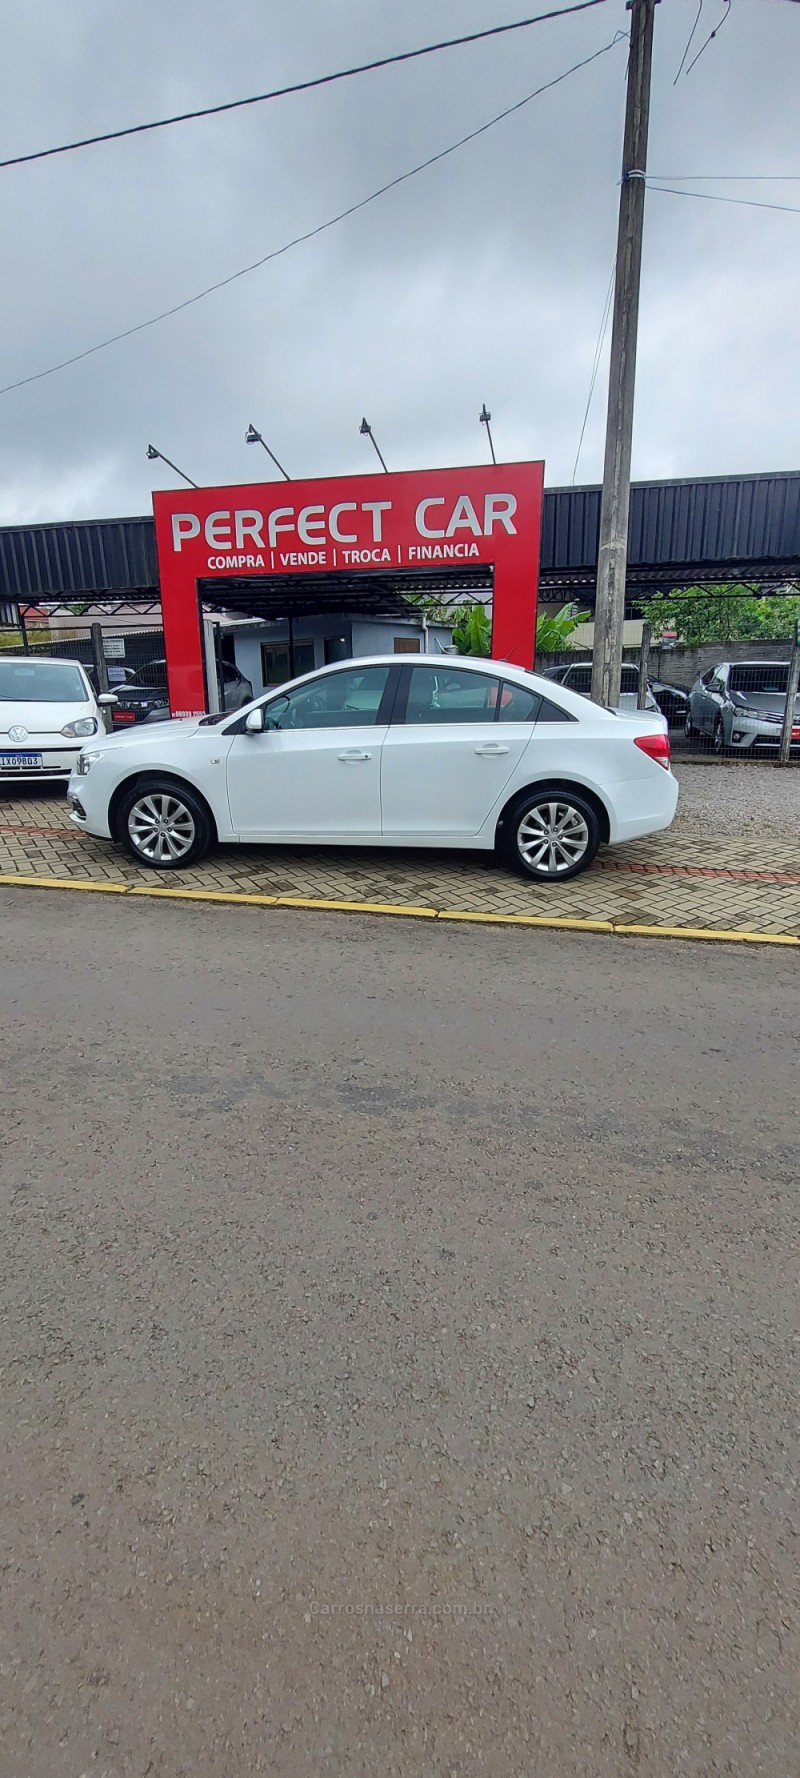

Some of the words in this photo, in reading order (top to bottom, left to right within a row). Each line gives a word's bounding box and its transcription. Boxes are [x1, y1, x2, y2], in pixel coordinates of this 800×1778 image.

[172, 501, 392, 553] PERFECT
[415, 493, 518, 539] CAR
[207, 553, 265, 570] COMPRA
[280, 551, 327, 567] VENDE
[342, 547, 391, 564] TROCA
[408, 543, 480, 560] FINANCIA
